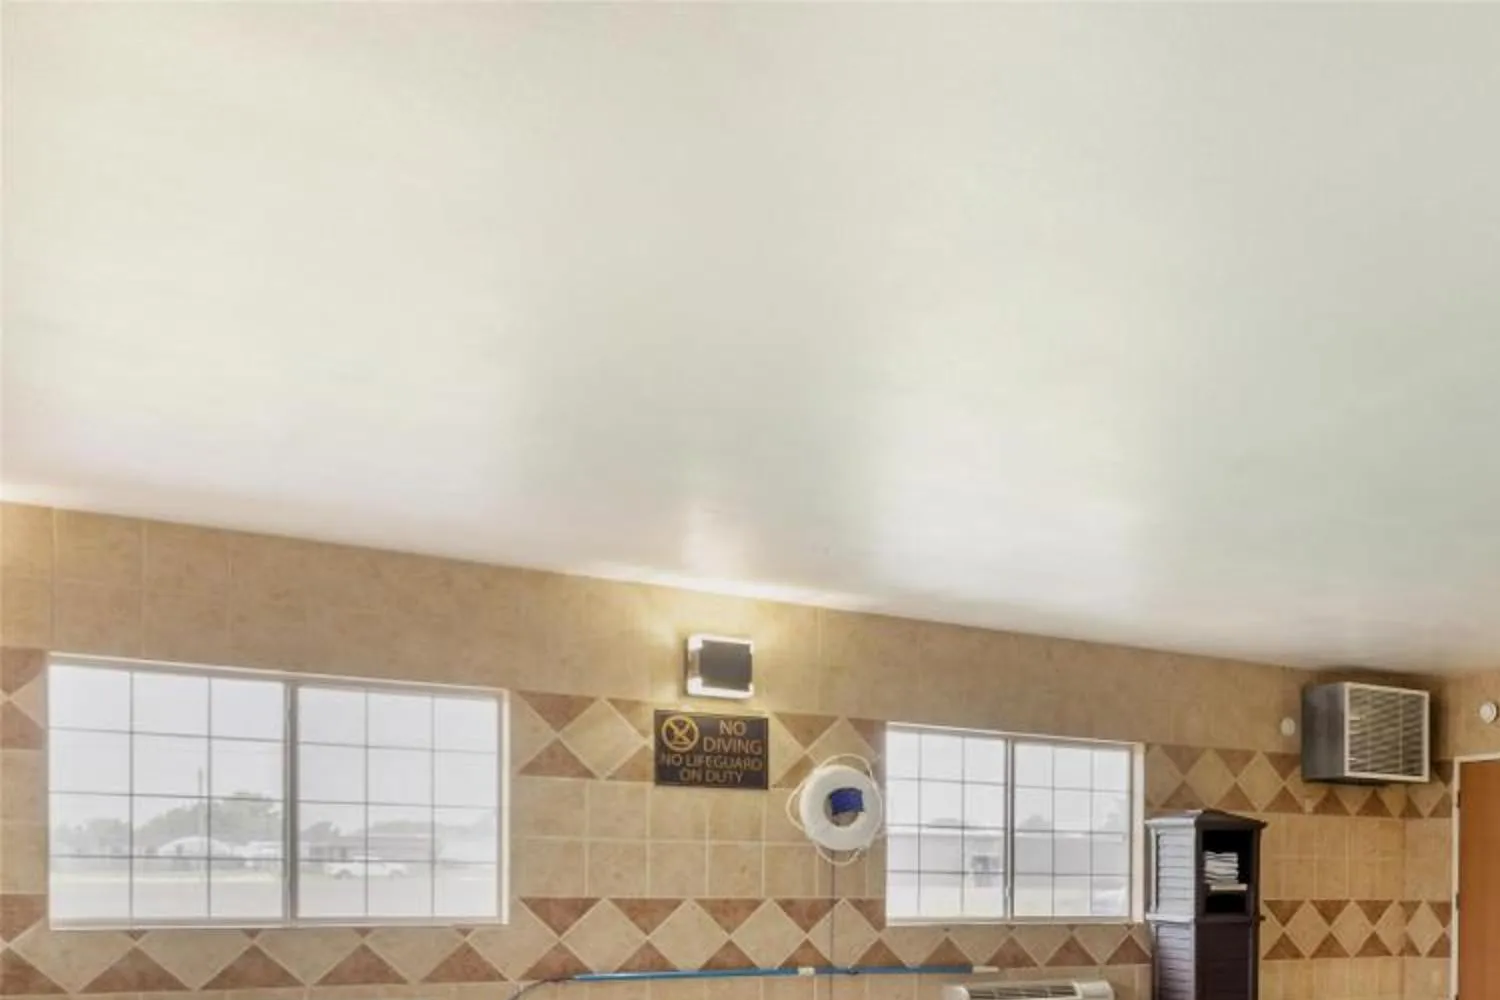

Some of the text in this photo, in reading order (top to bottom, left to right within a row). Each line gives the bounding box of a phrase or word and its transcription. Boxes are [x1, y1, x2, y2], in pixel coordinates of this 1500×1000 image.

[720, 719, 747, 737] NO
[703, 736, 763, 755] DIVING
[661, 753, 682, 767] NO
[680, 768, 744, 784] ON DUTY
